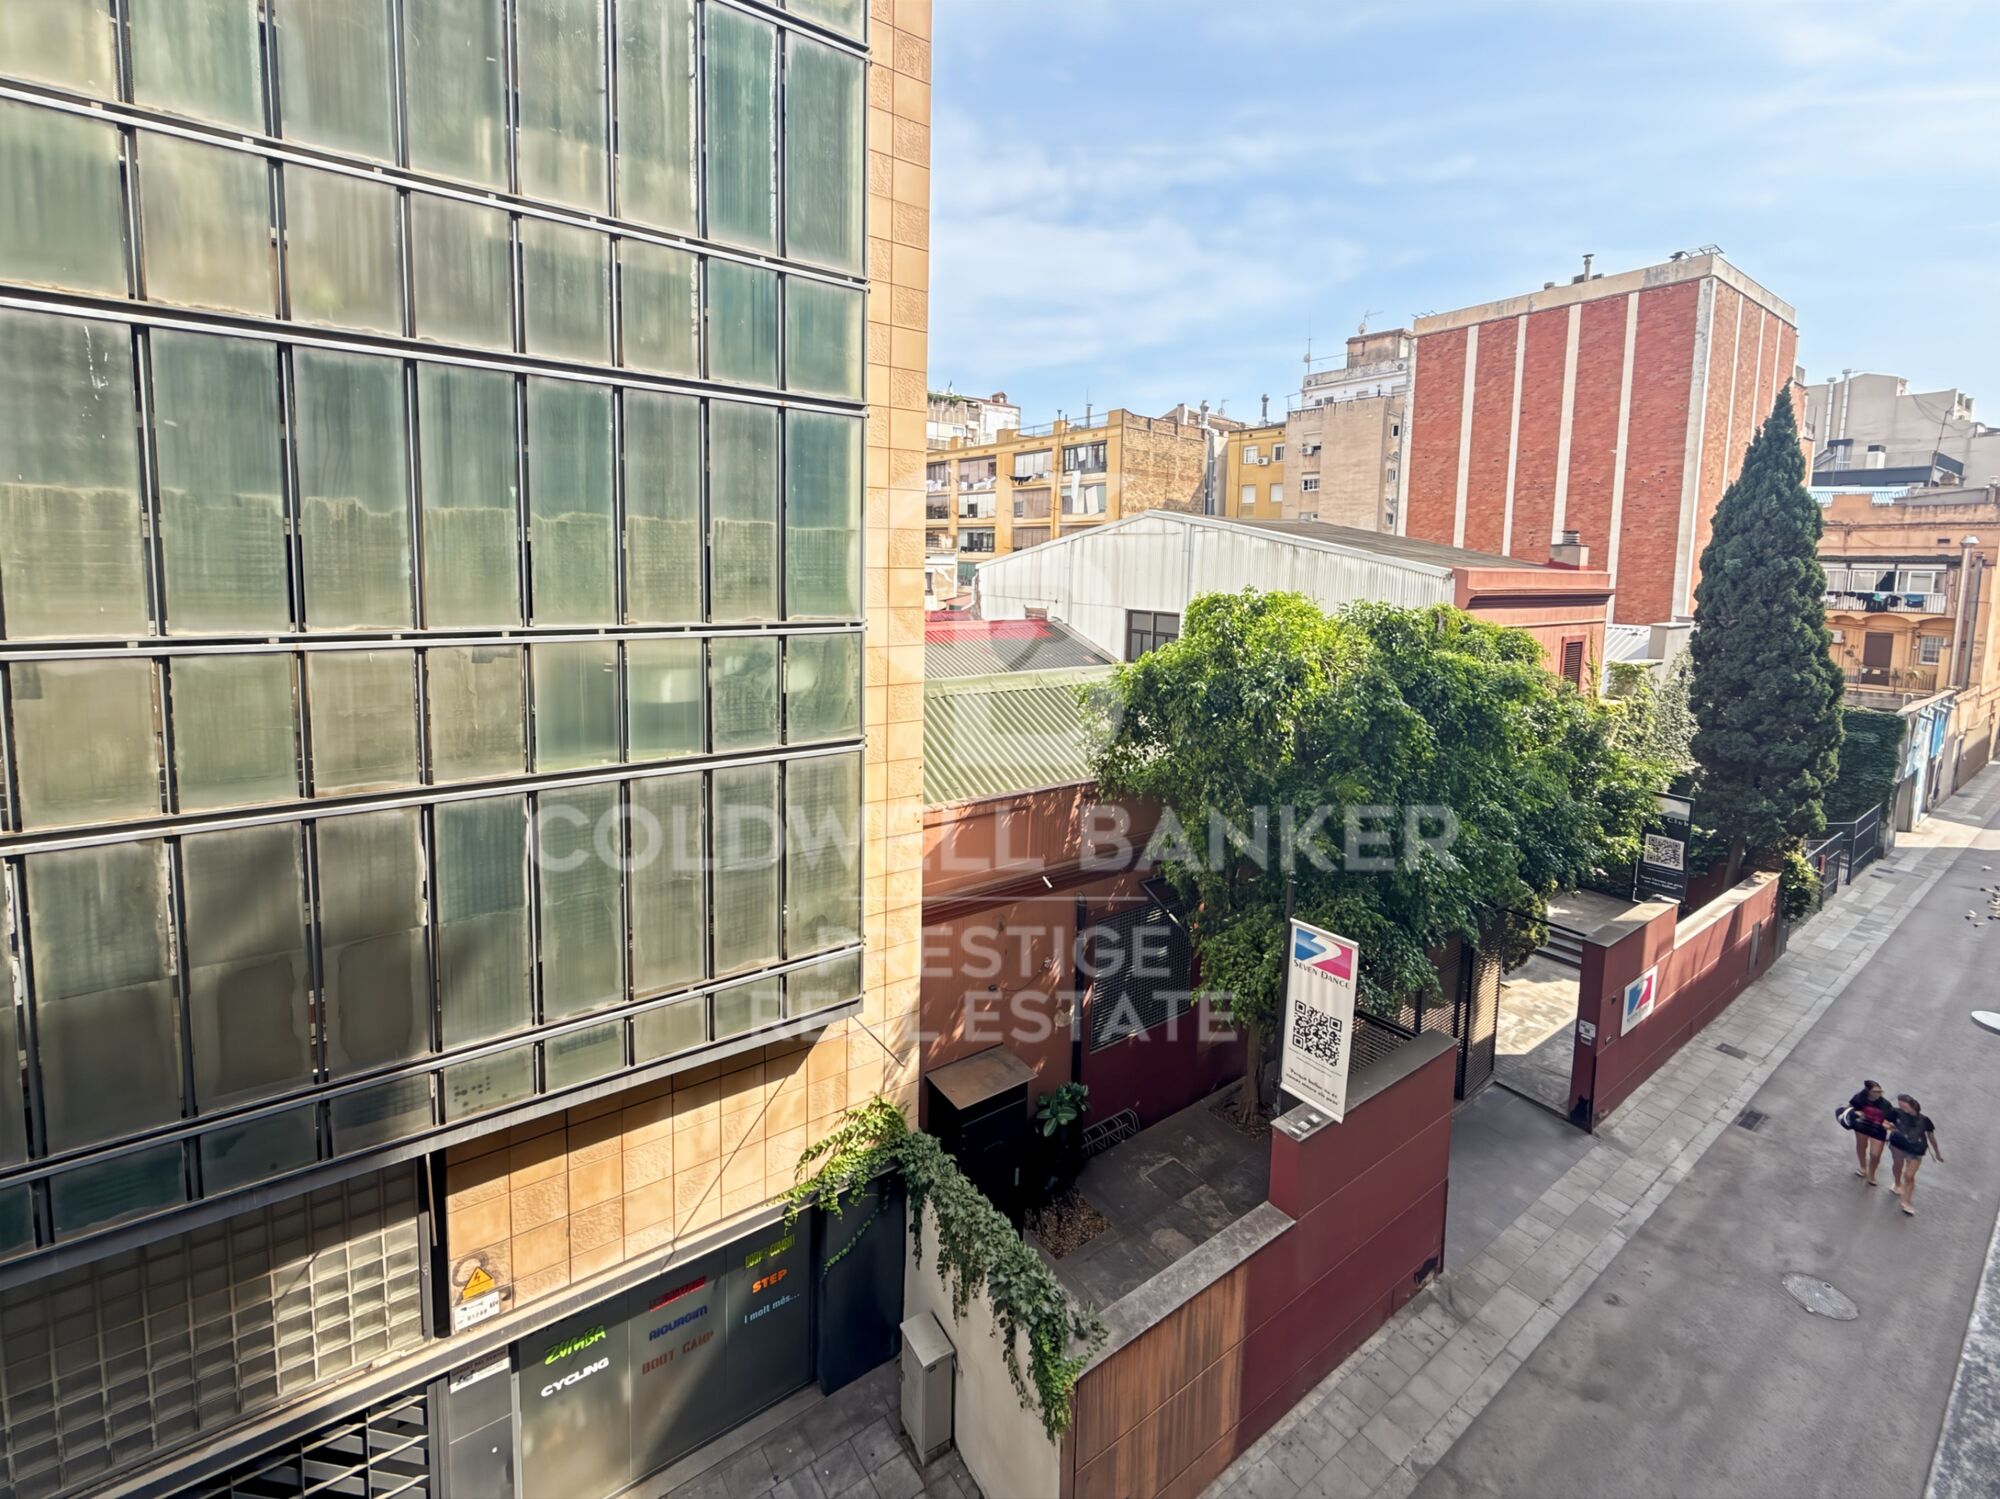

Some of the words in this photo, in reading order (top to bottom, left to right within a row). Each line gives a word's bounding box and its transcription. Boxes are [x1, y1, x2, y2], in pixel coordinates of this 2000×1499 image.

[1320, 970, 1351, 989] DANCE
[752, 1268, 788, 1294] STEP
[749, 1303, 771, 1321] molt
[544, 1324, 607, 1366] ZUMBA
[540, 1356, 610, 1398] CYCLING
